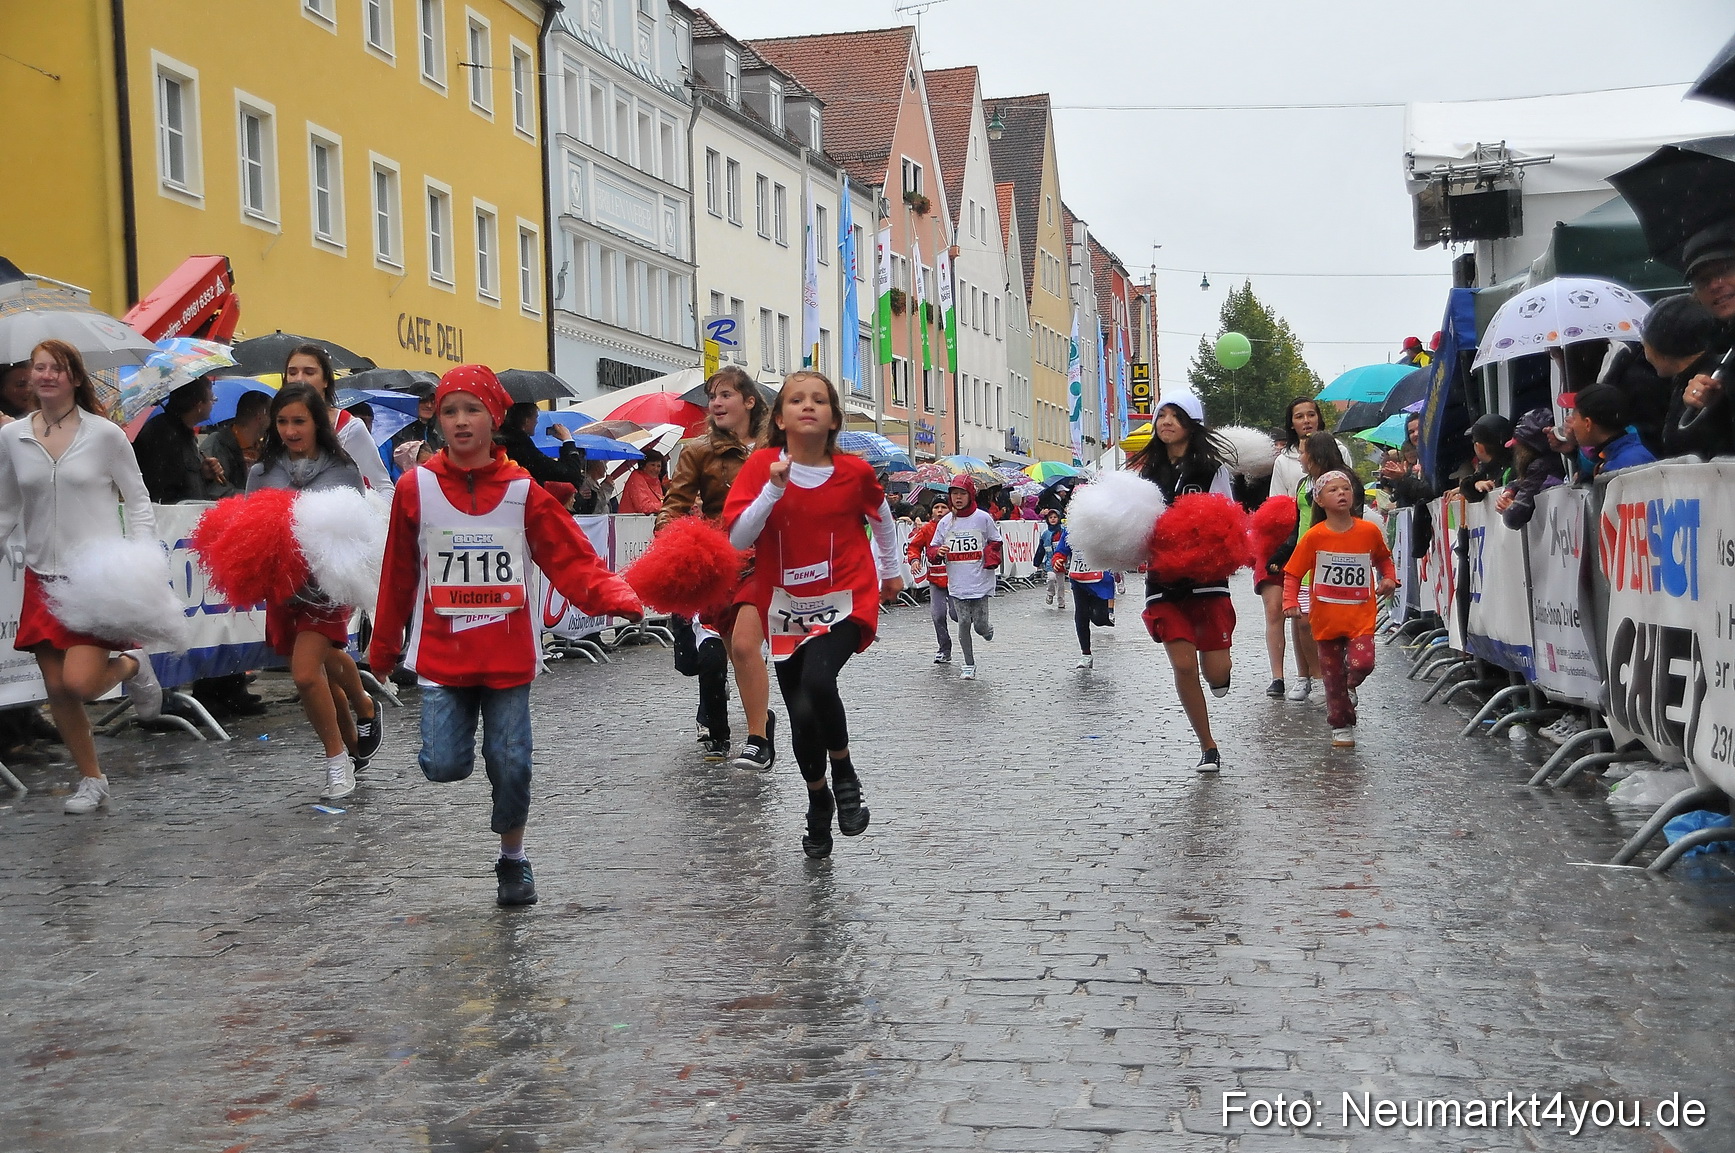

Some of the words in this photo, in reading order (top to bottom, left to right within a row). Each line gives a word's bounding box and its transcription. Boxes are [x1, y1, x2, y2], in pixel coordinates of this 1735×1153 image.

[597, 188, 626, 219] BRILLEN
[182, 299, 201, 324] 09181
[200, 286, 215, 308] 6352
[397, 312, 432, 355] CAFE
[437, 322, 464, 363] DELI
[452, 533, 494, 544] BOCK
[949, 538, 978, 552] 7153
[438, 551, 513, 583] 7118
[793, 570, 816, 580] DEHN
[1321, 564, 1365, 586] 7368
[450, 590, 502, 605] Victoria
